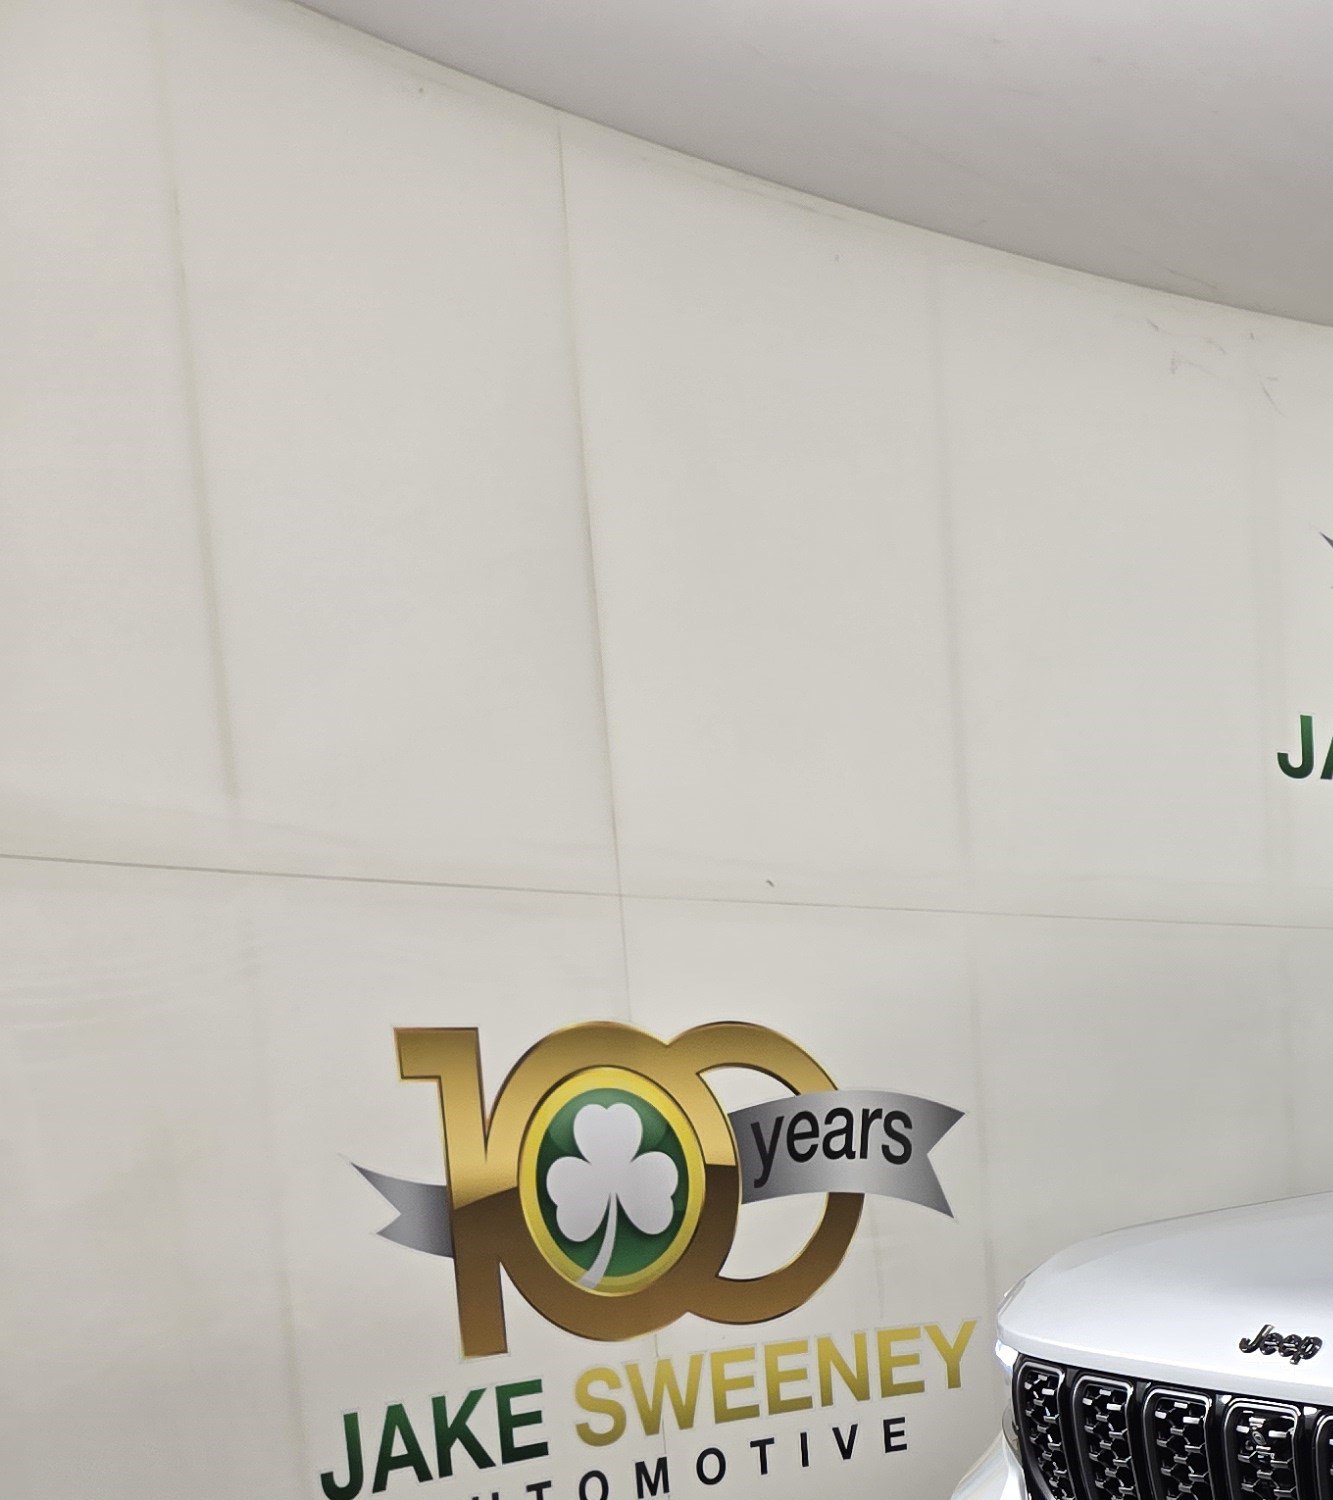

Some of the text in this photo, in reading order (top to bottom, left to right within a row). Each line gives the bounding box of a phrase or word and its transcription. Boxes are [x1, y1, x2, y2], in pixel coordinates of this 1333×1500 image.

[394, 1021, 913, 1358] 100 years
[575, 1321, 977, 1448] SWEENEY
[1239, 1324, 1323, 1365] Jeep
